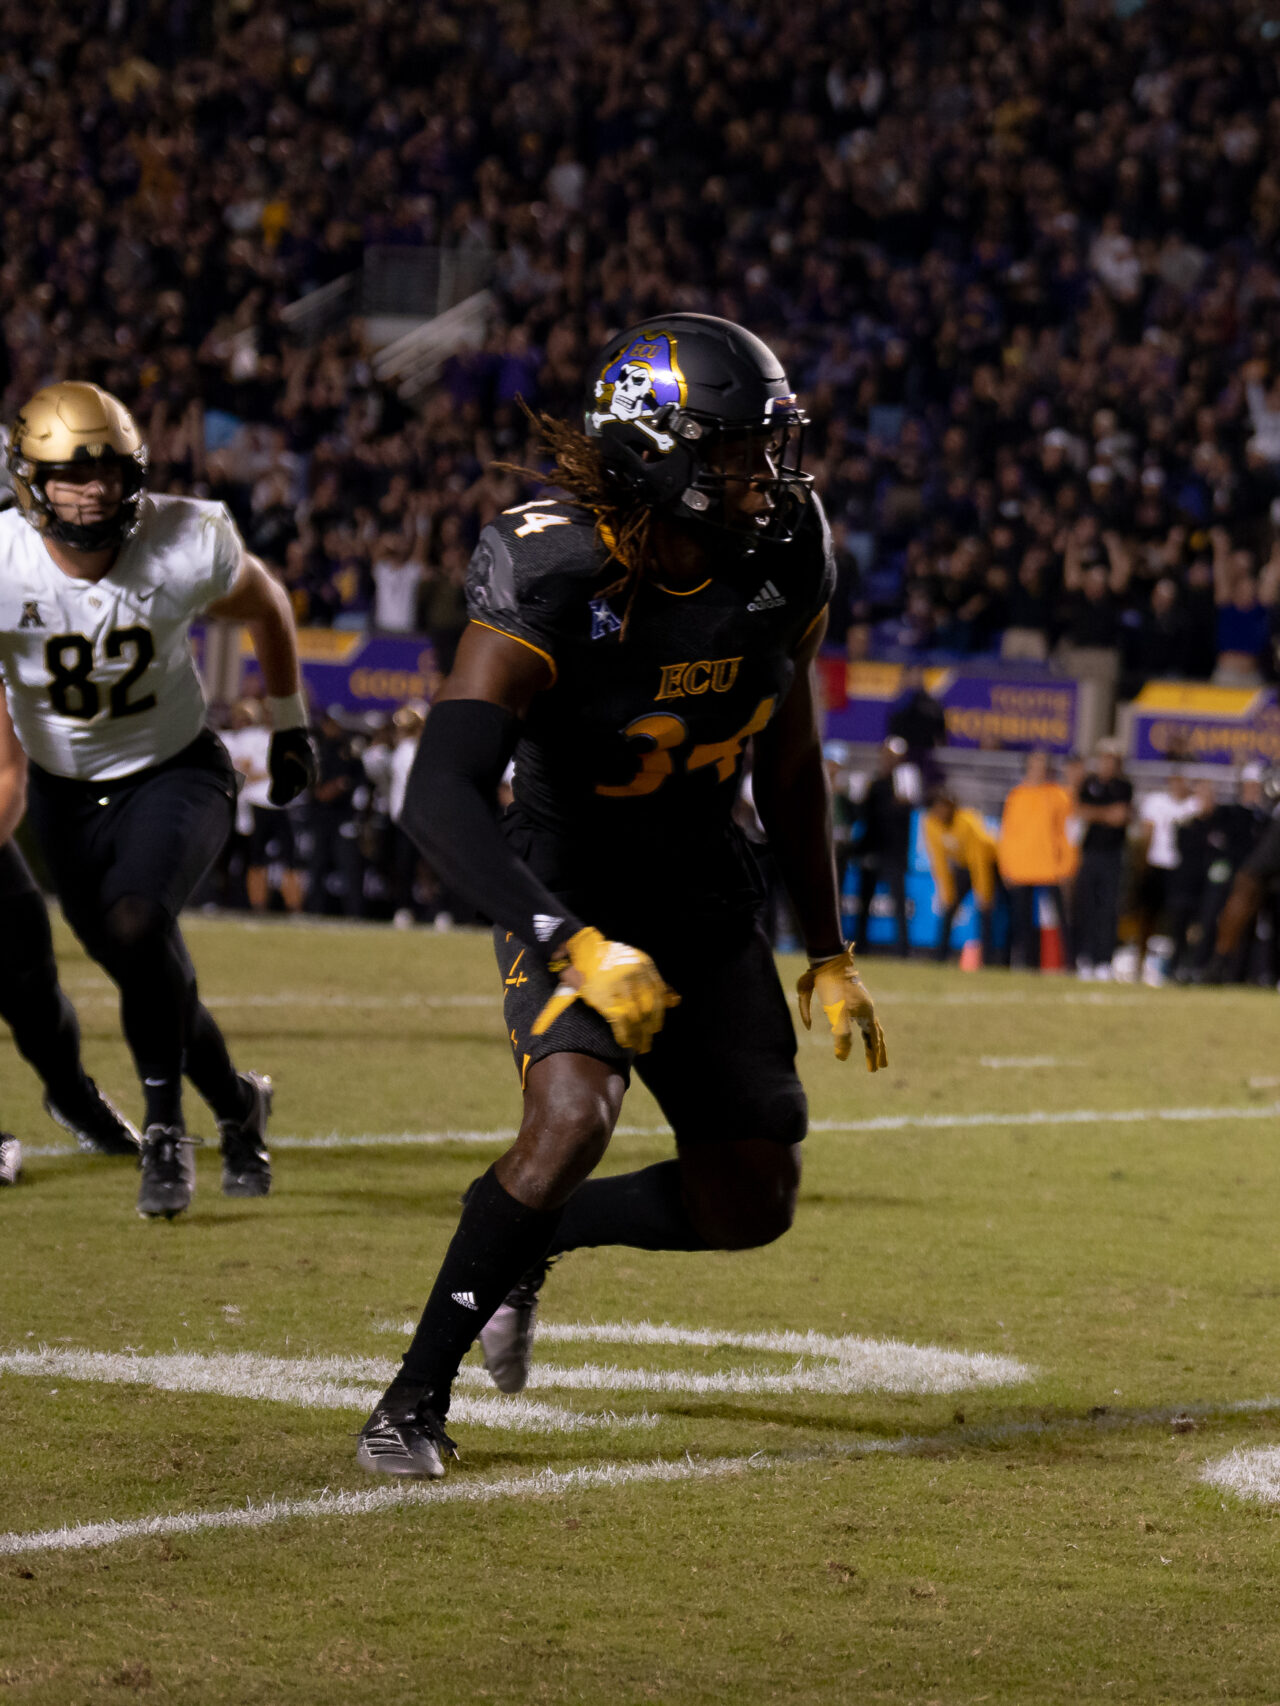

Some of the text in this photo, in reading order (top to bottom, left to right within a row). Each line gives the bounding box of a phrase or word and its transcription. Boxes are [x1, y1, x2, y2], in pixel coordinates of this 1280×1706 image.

[629, 343, 662, 359] ECU
[45, 624, 157, 720] 82
[654, 656, 744, 701] ECU
[595, 693, 777, 797] 34
